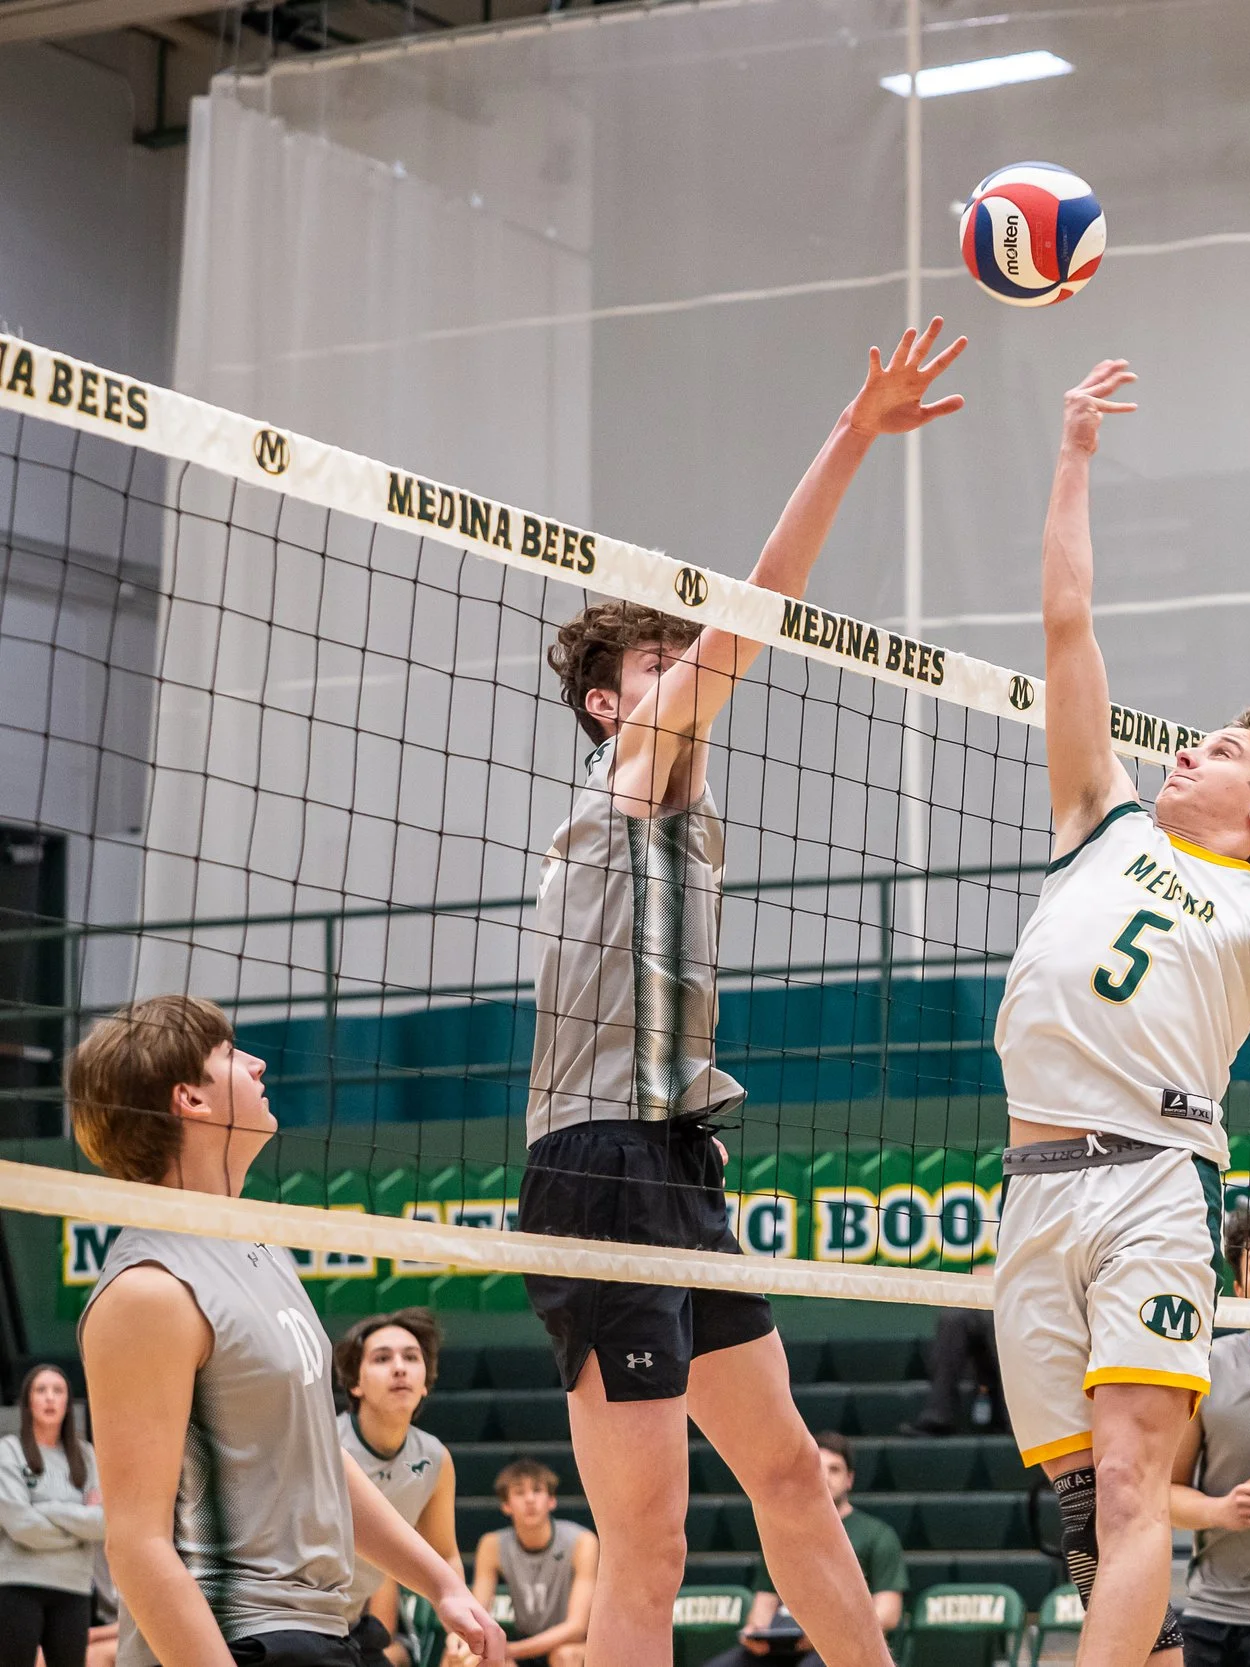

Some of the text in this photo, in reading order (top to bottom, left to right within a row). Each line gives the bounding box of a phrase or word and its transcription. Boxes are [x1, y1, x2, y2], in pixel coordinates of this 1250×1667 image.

[1003, 215, 1019, 275] molten
[0, 341, 148, 431] A BEES
[387, 471, 596, 576] MEDINA BEES
[780, 598, 946, 687] MEDINA BEES
[1109, 703, 1170, 755] EDINA
[1092, 908, 1177, 1003] 5
[1142, 1293, 1199, 1341] M
